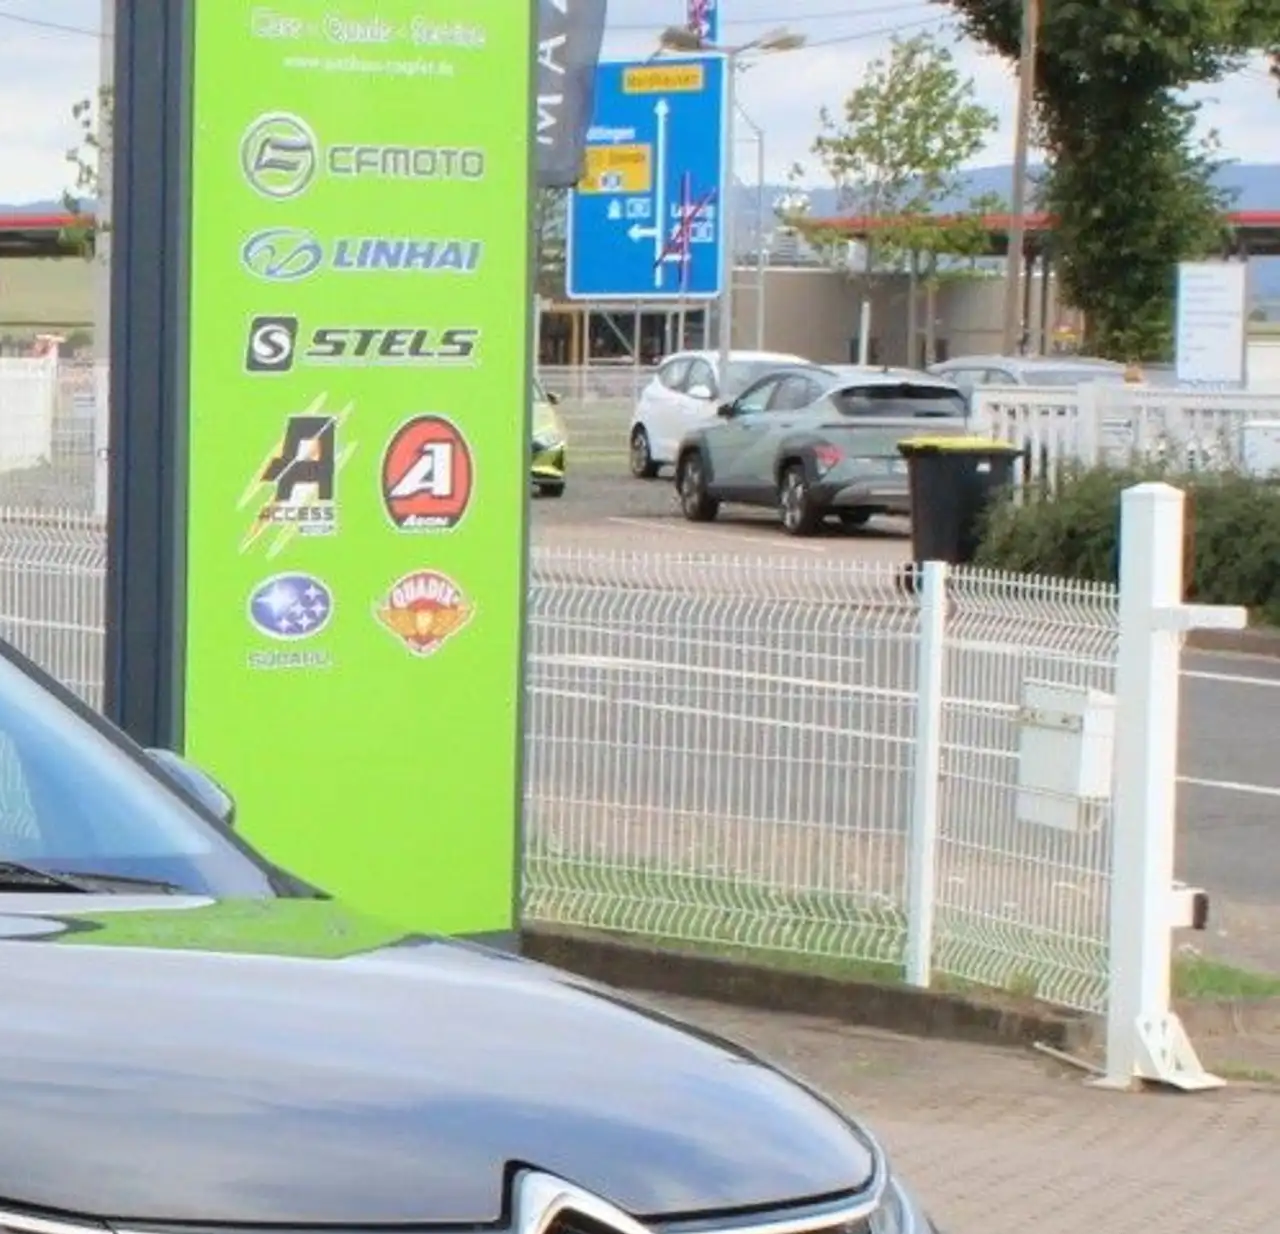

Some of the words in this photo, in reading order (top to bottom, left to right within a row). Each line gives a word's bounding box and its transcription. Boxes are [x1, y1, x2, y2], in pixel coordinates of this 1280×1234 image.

[328, 146, 485, 178] CFMOTO
[333, 239, 481, 270] LINHAI
[307, 329, 478, 357] STELS
[259, 506, 334, 521] ACCESS
